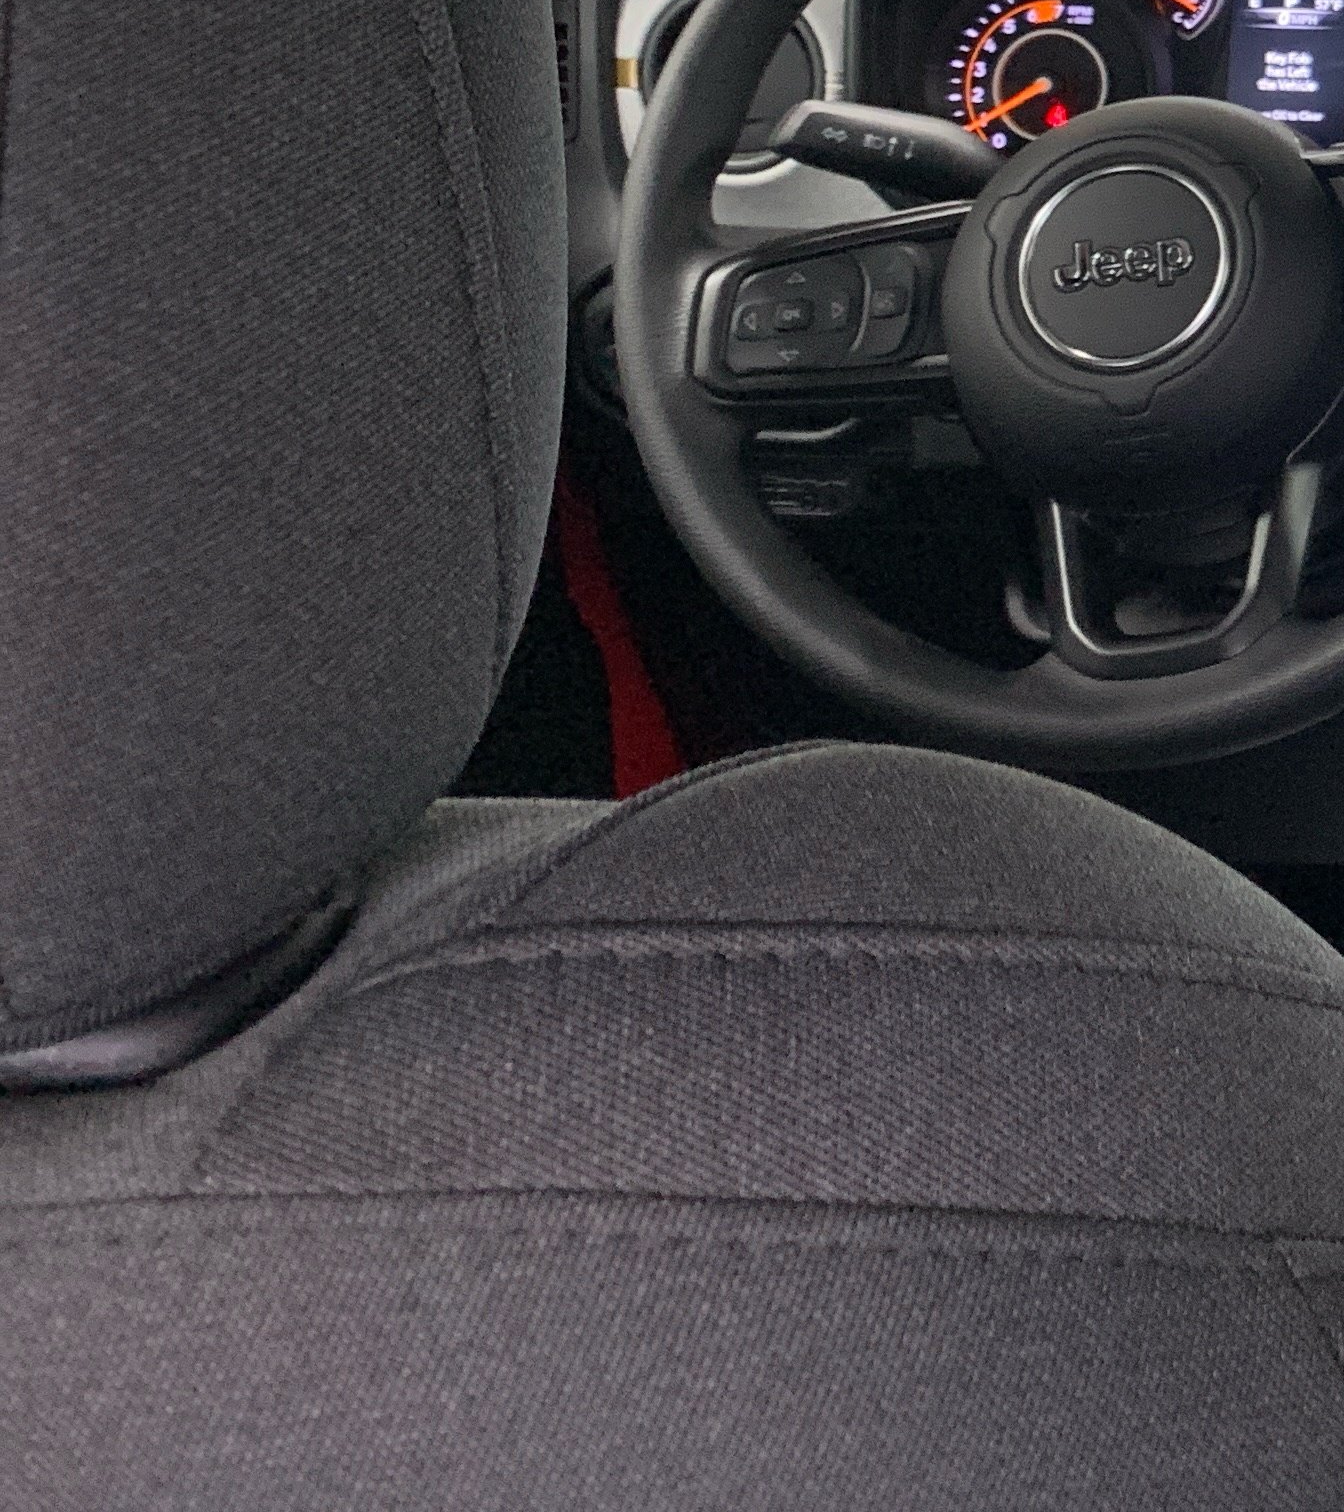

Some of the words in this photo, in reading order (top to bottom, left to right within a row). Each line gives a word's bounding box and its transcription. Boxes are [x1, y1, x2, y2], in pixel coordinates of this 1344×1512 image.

[1001, 18, 1017, 35] 5
[1276, 10, 1291, 26] 0
[1291, 13, 1319, 26] MPH
[1263, 50, 1287, 67] Key
[973, 61, 987, 78] 3
[1278, 78, 1320, 92] Vehicle
[971, 86, 985, 104] 2
[992, 131, 1008, 149] 0
[1053, 236, 1195, 294] Jeep
